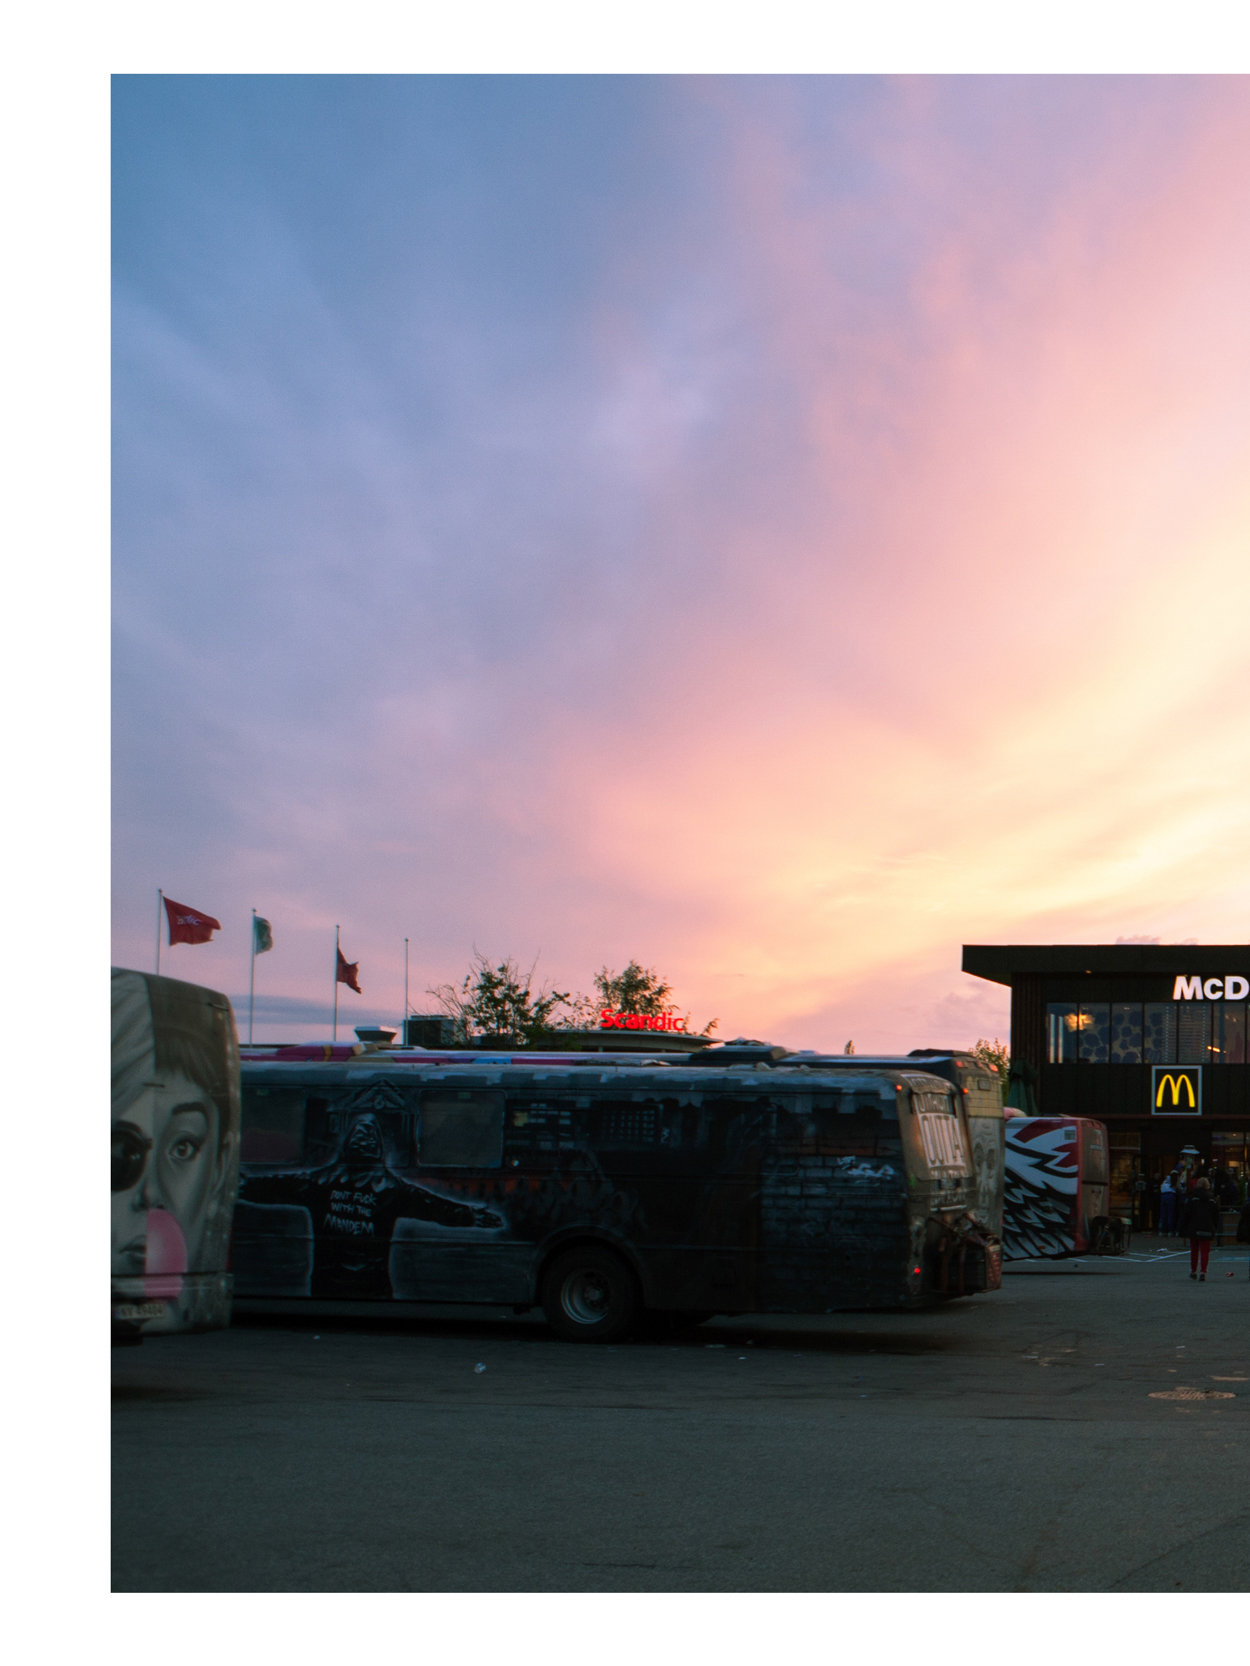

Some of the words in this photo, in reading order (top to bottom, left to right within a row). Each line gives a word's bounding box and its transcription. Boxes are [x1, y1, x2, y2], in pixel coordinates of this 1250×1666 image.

[601, 1009, 684, 1031] Scandic
[353, 1191, 377, 1206] FUCK
[331, 1202, 355, 1213] WITH
[356, 1205, 372, 1217] THE
[323, 1213, 375, 1238] MANDEM
